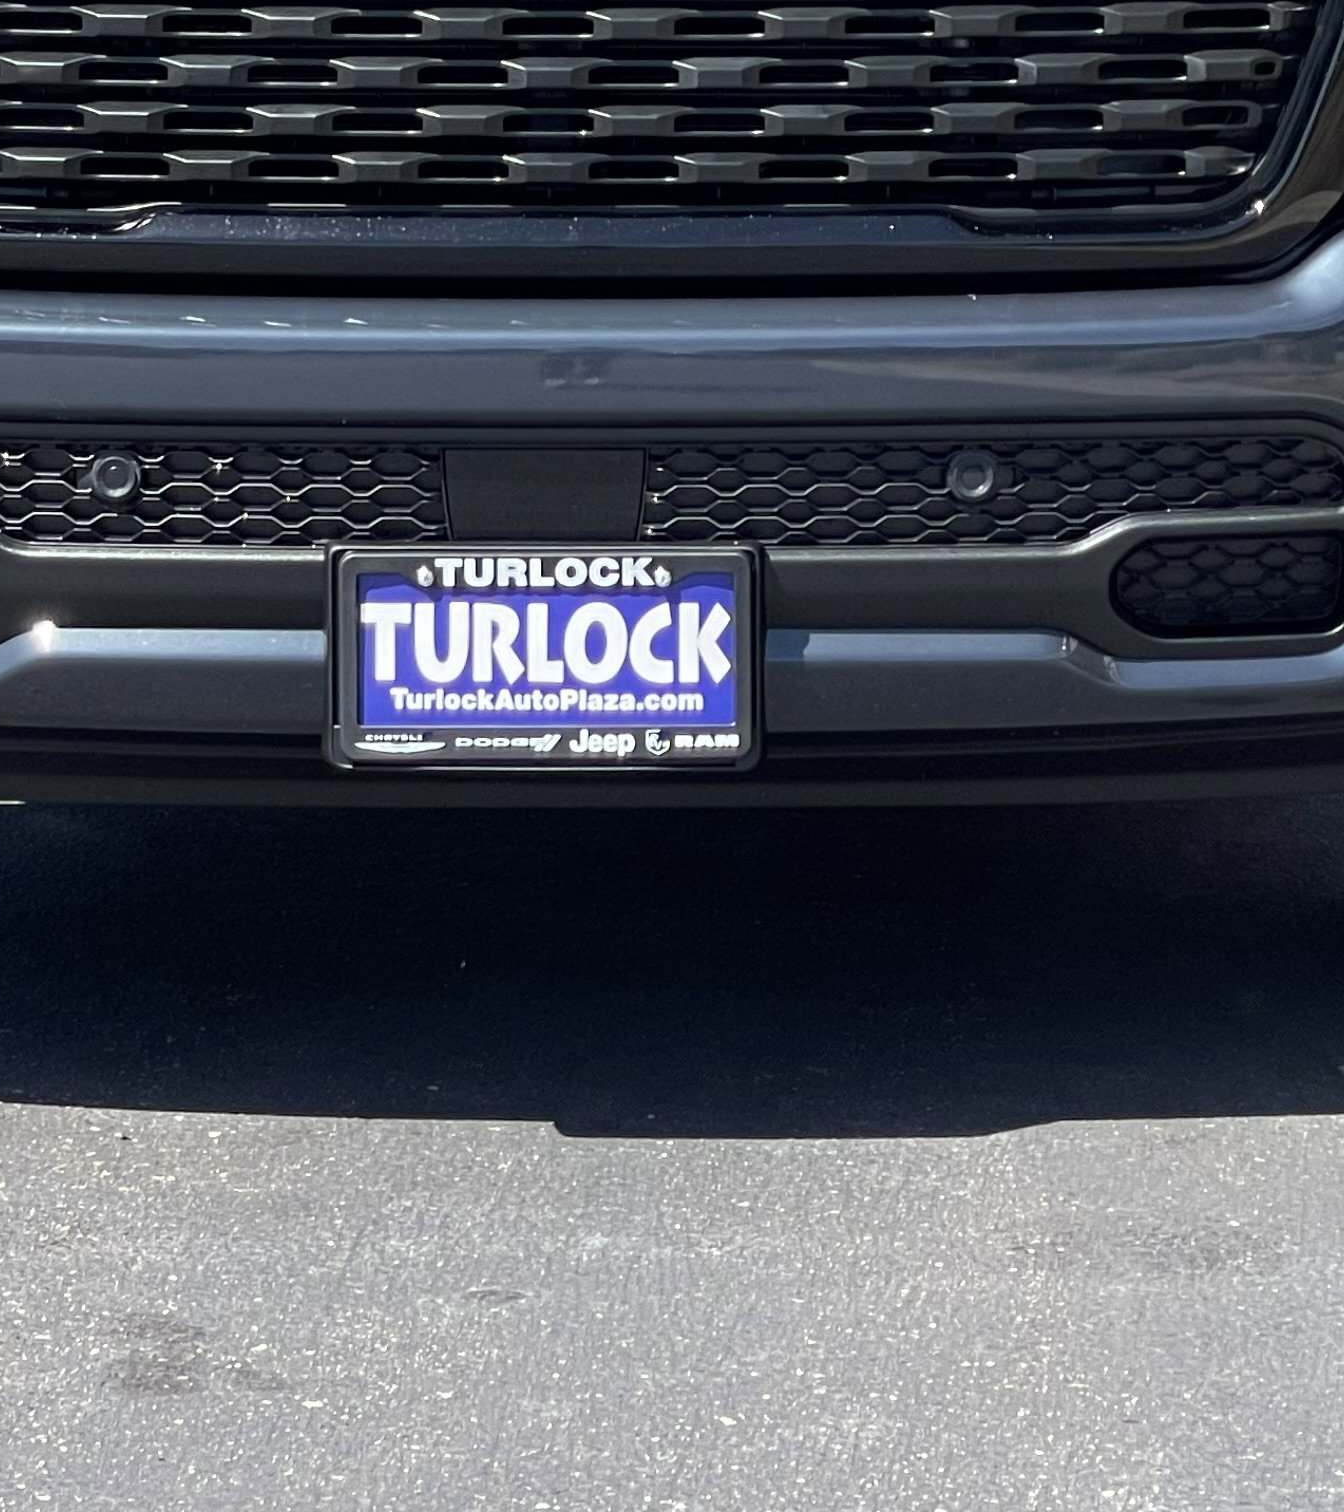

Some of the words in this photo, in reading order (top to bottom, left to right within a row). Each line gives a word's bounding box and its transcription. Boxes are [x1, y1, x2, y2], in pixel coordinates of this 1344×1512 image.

[434, 557, 657, 588] TURLOCK
[360, 601, 732, 685] TURLOCK
[390, 688, 704, 712] TurlockAutoPlaza.com
[569, 728, 636, 757] Jeep
[674, 734, 740, 748] RAM
